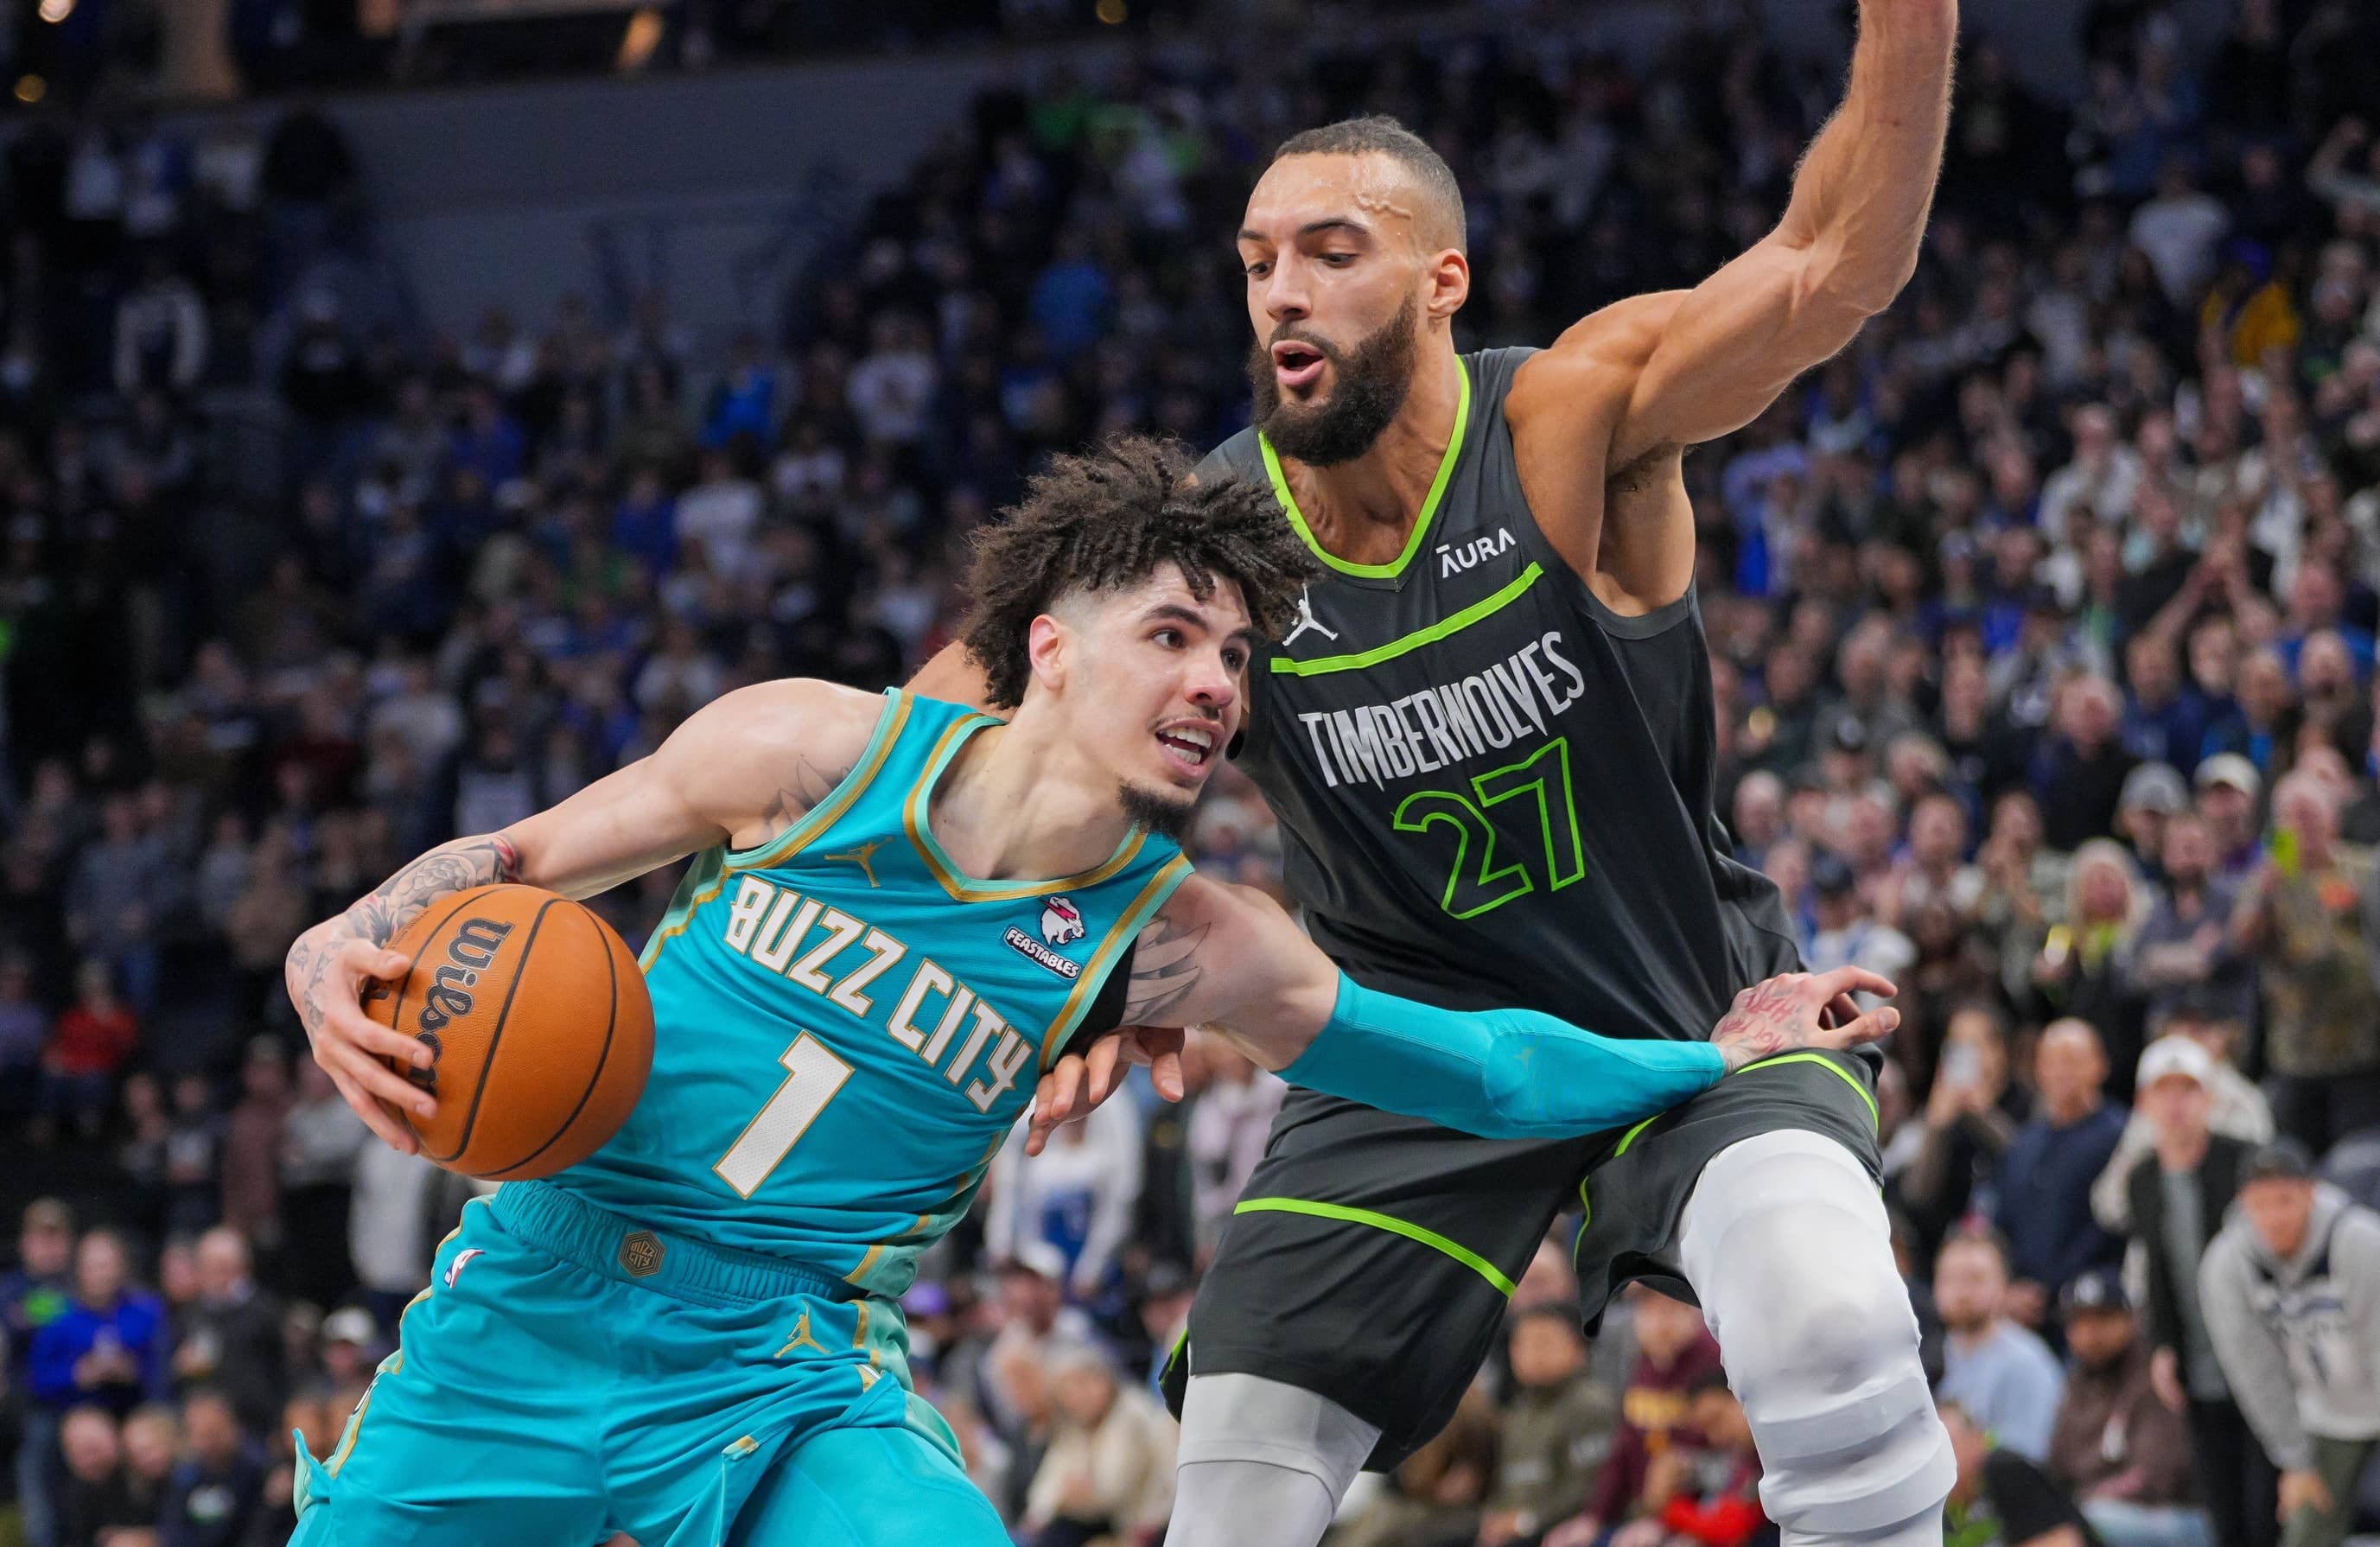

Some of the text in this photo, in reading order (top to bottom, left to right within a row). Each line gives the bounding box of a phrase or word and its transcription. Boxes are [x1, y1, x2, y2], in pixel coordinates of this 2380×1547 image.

[1297, 631, 1585, 793] TIMBERWOLVES
[1392, 735, 1585, 920] 27
[723, 873, 1034, 1115] BUZZ CITY
[1006, 928, 1079, 977] FEASTABLES
[715, 1029, 856, 1200] 1
[628, 1251, 652, 1269] CITY
[630, 1239, 655, 1258] BUZZ
